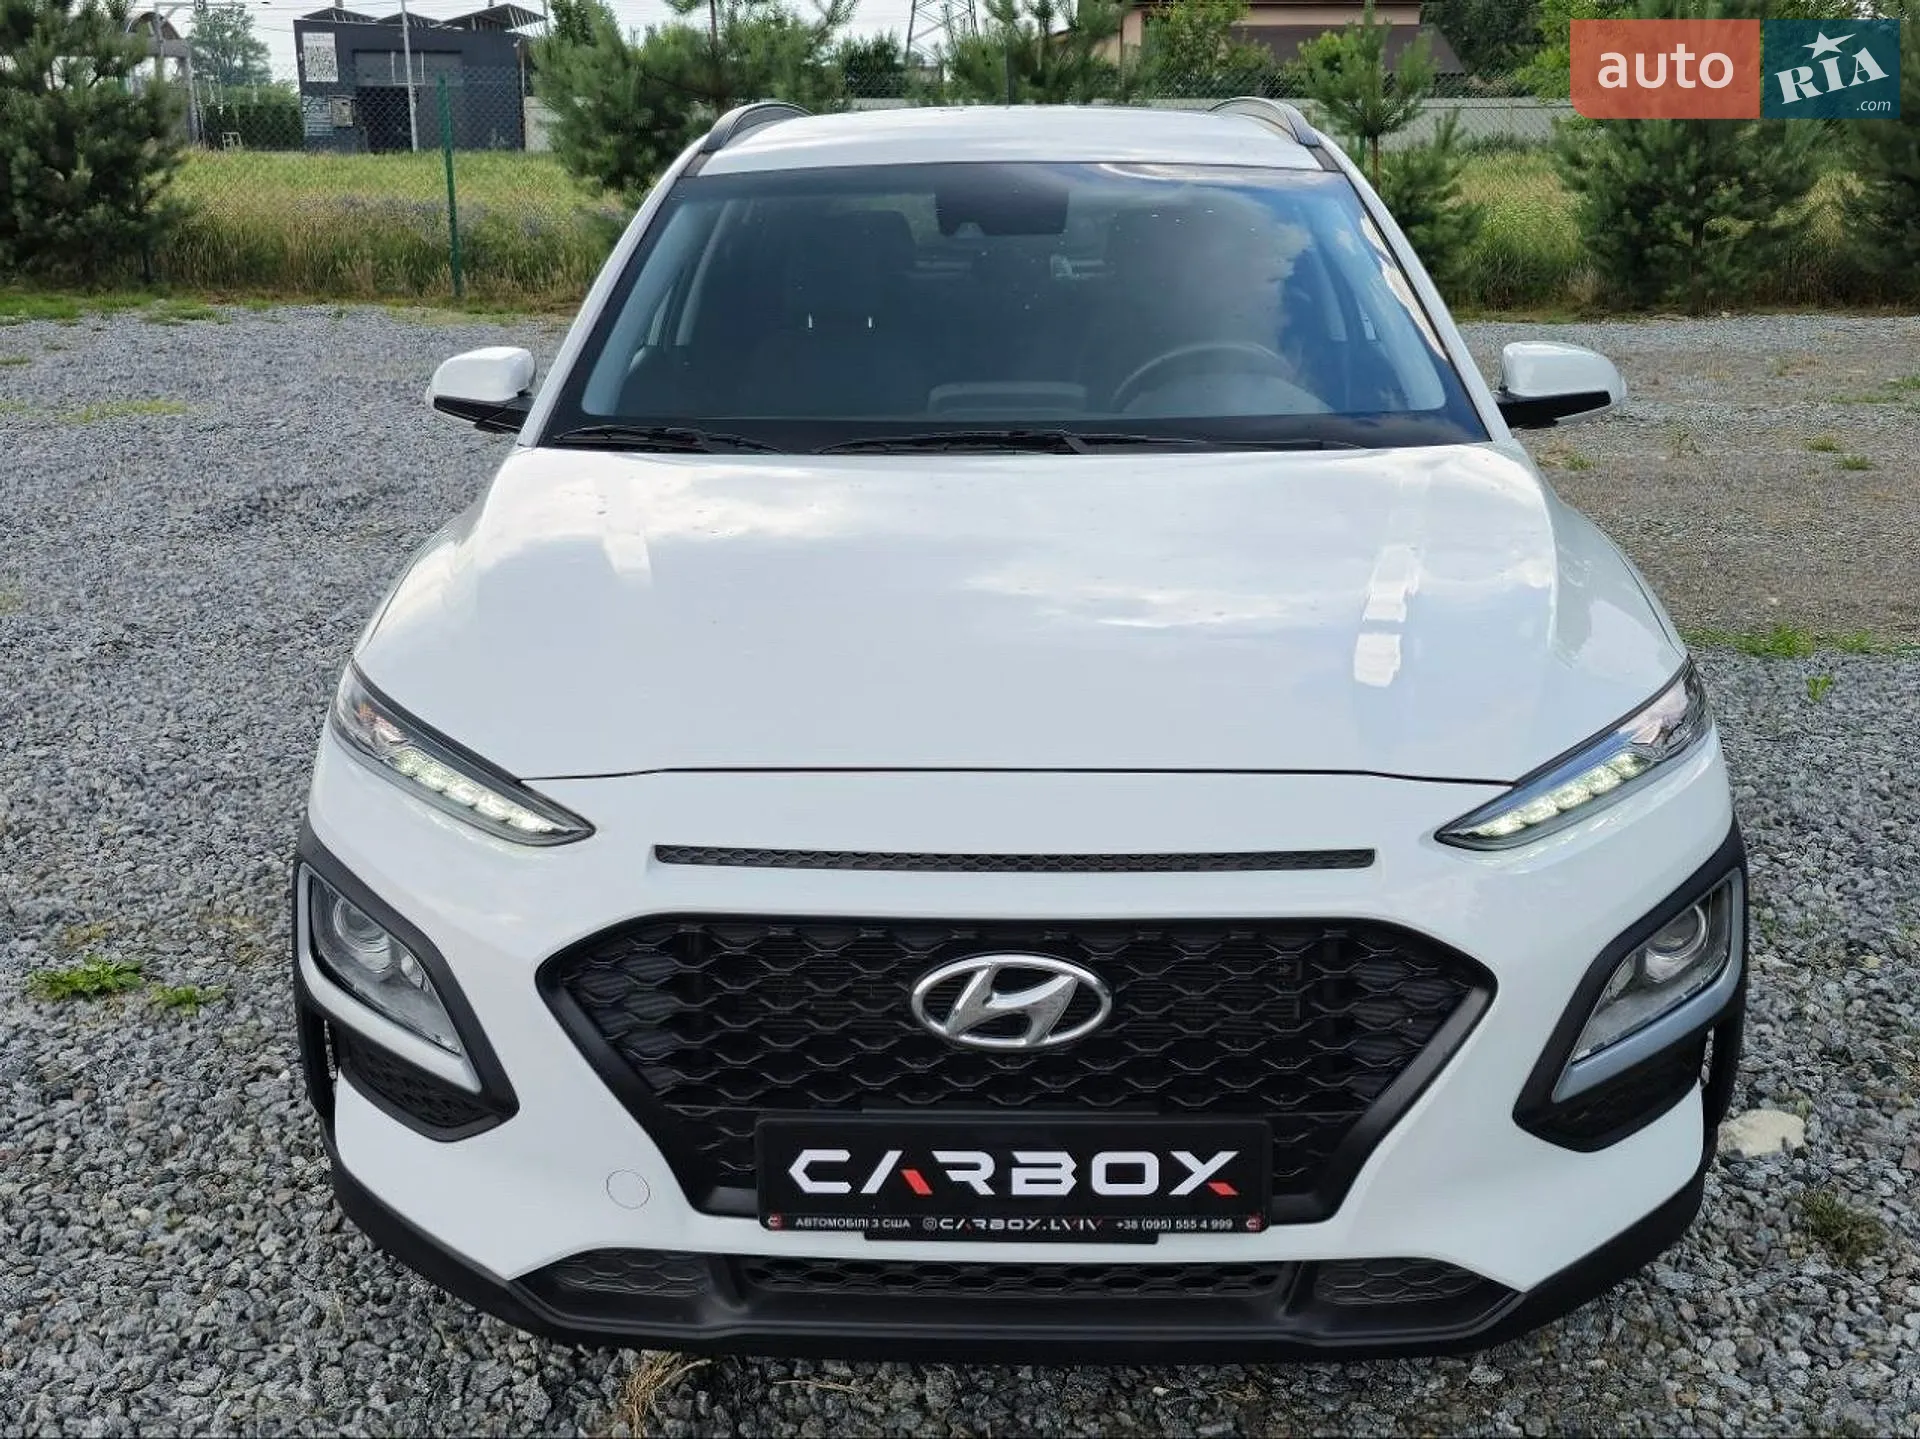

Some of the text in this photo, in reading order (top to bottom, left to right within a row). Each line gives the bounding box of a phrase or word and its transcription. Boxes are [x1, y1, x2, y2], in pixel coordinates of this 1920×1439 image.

[788, 1148, 1239, 1196] CARBOX
[795, 1217, 869, 1229] АВТОМОБІЛІ
[882, 1218, 911, 1229] США
[938, 1218, 1103, 1231] CARBOX.LVIV
[1116, 1218, 1234, 1231] +38 (095) 555 4 999
